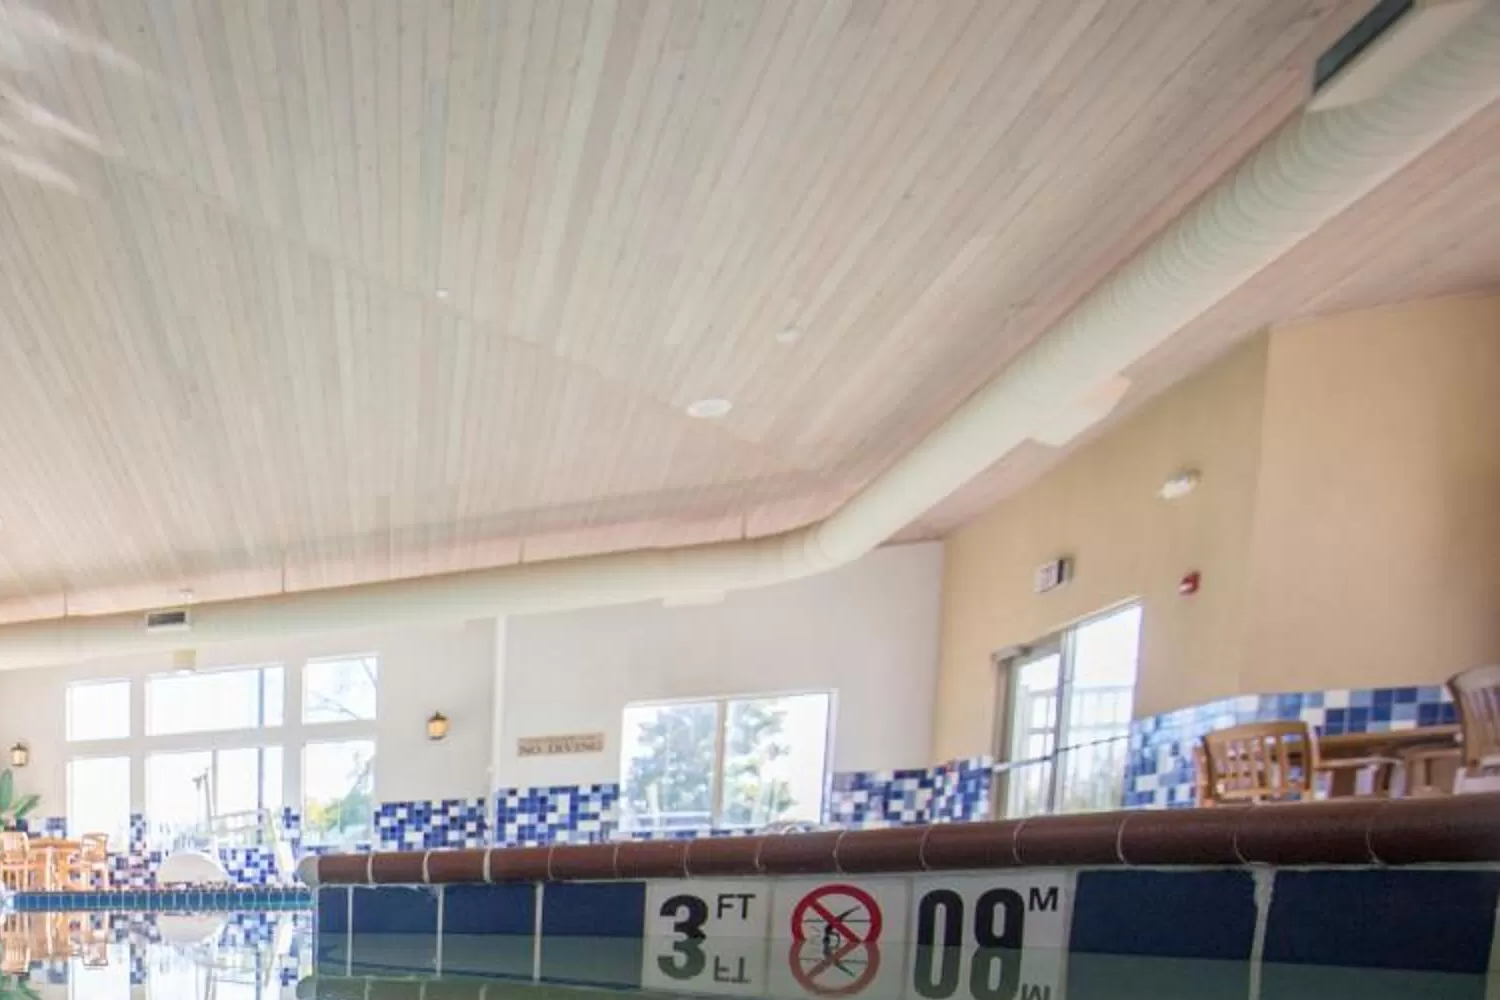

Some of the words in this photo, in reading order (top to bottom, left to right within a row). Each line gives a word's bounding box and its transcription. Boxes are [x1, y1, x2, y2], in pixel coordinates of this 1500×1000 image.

[517, 743, 542, 757] NO
[547, 740, 603, 754] DIVING
[1028, 886, 1059, 912] M
[657, 894, 709, 980] 3
[717, 893, 756, 919] FT
